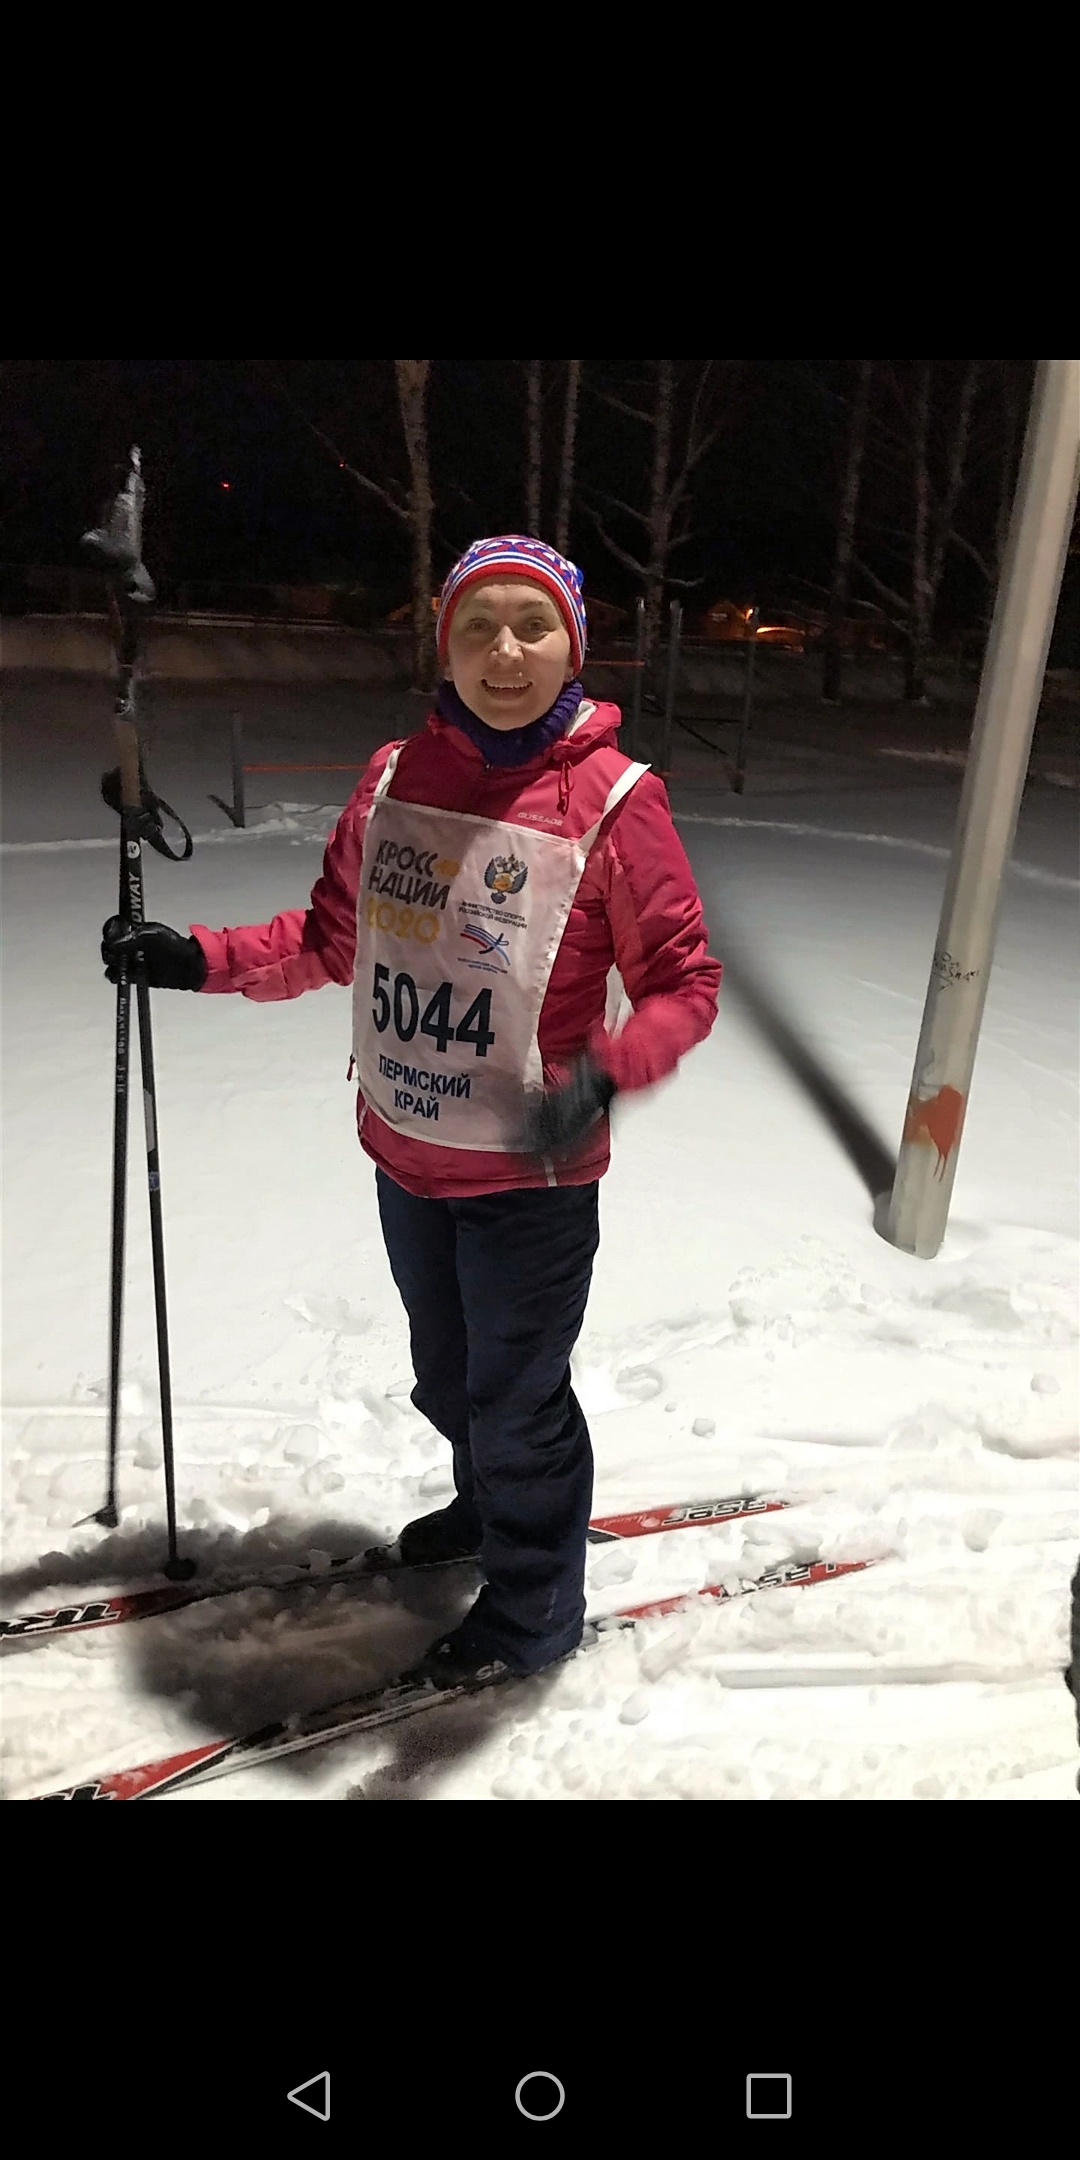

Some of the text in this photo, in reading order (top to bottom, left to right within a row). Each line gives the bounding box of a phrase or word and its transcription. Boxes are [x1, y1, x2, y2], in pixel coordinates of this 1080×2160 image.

[376, 839, 438, 878] КРОСС
[368, 866, 451, 910] НАЦИИ
[372, 962, 495, 1057] 5044
[379, 1053, 471, 1099] ПЕРМСКИЙ
[394, 1088, 440, 1121] КРАЙ
